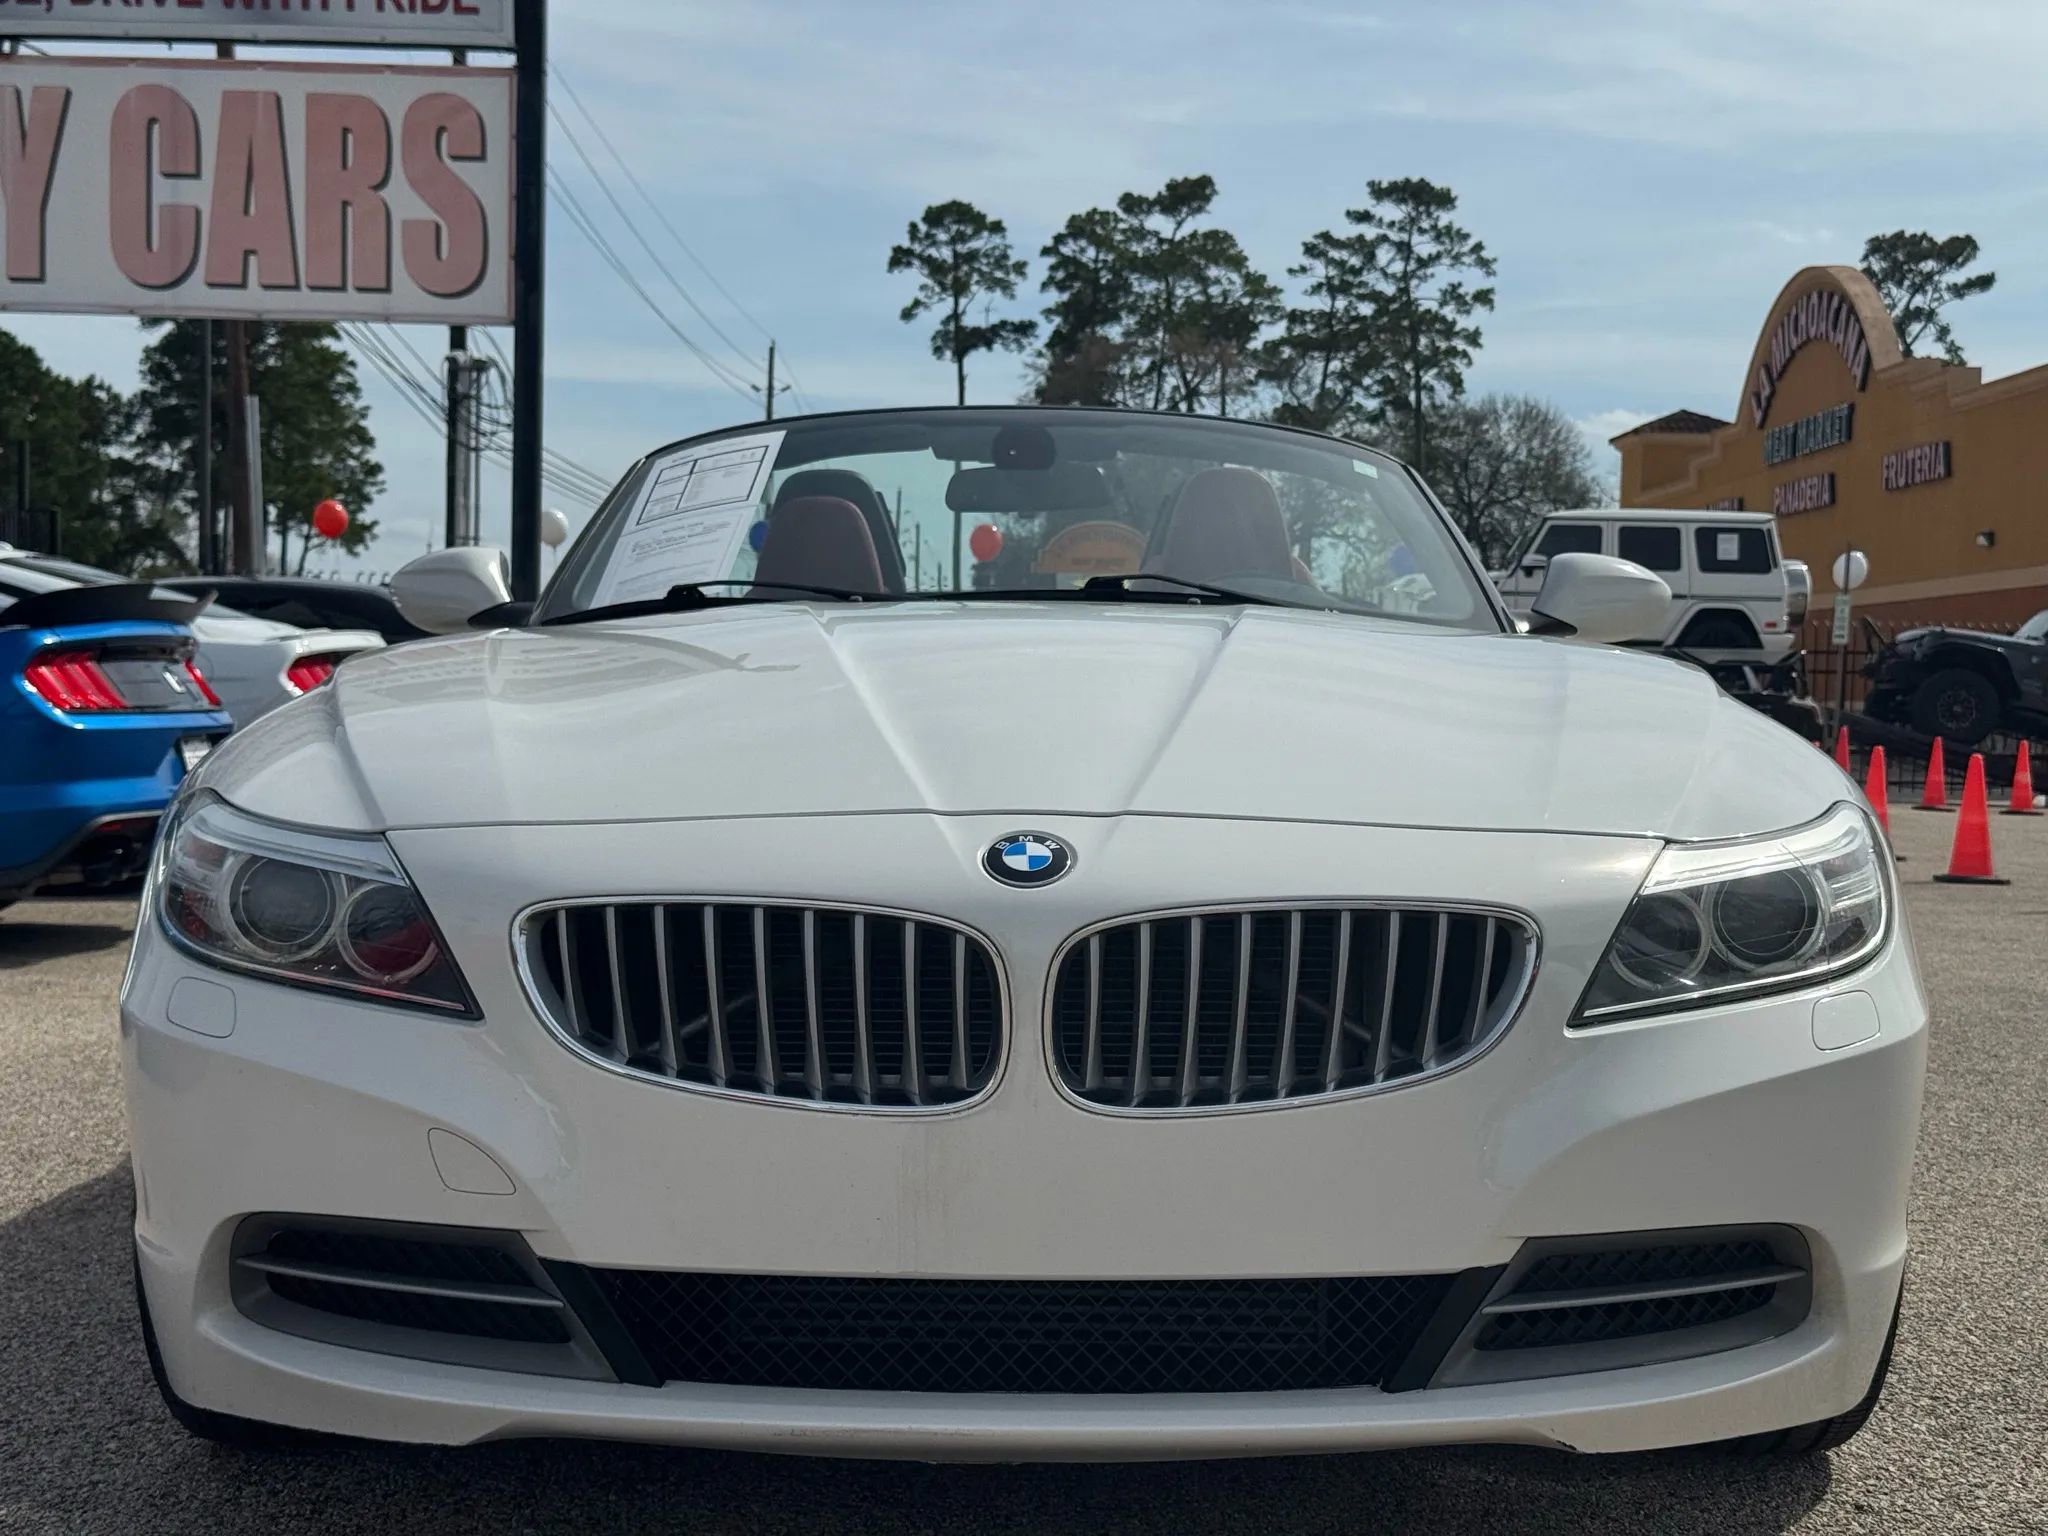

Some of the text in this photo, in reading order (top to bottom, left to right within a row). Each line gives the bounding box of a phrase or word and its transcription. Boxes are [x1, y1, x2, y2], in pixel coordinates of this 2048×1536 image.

[108, 83, 487, 298] CARS
[1751, 291, 1869, 429] LA MICHOACANA
[1764, 402, 1852, 464] MEAT MARKET
[1882, 441, 1950, 490] FRUTERIA
[1774, 473, 1833, 515] PANADERIA
[992, 836, 1060, 849] BMW
